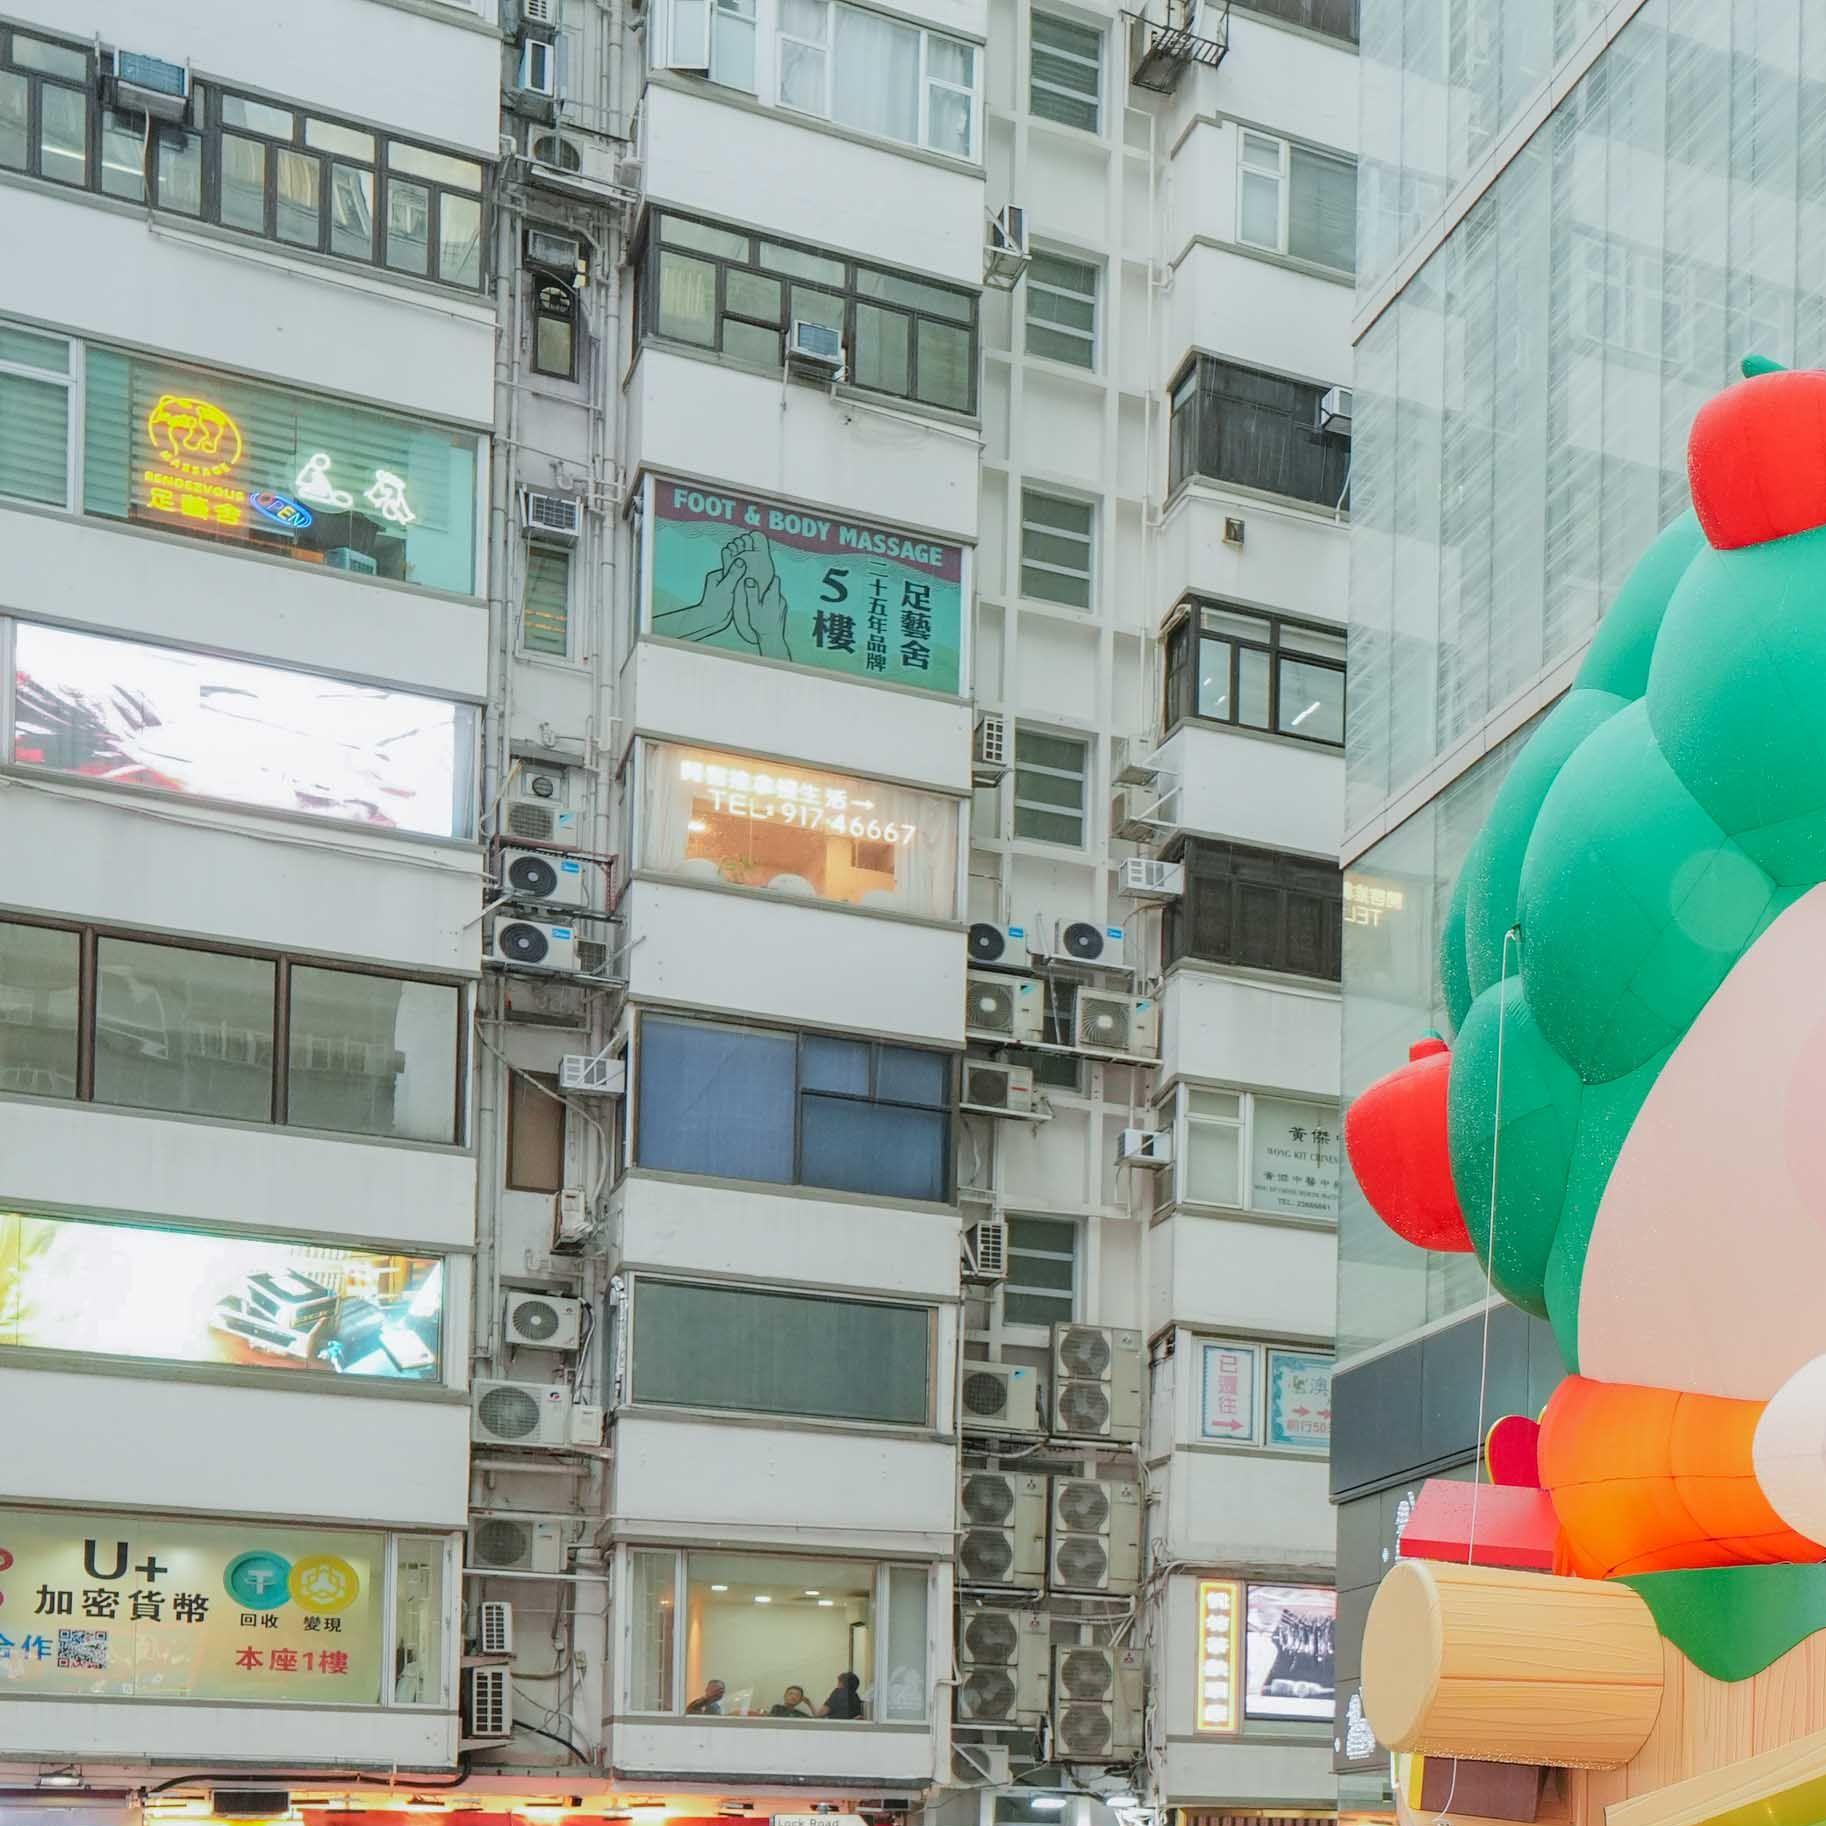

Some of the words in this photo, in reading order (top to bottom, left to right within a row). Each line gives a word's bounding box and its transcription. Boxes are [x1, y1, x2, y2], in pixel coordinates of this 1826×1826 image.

[258, 493, 305, 526] OPEN
[673, 488, 736, 520] FOOT
[744, 505, 761, 527] &
[768, 511, 831, 541] BODY
[839, 526, 944, 567] MASSAGE
[866, 559, 888, 672] 二十五年品牌
[901, 580, 932, 671] 足藝舍
[33, 1583, 210, 1624] 加密貨幣
[240, 1612, 280, 1629] 回收
[303, 1614, 343, 1633] 變現
[235, 1645, 350, 1675] 本座1樓
